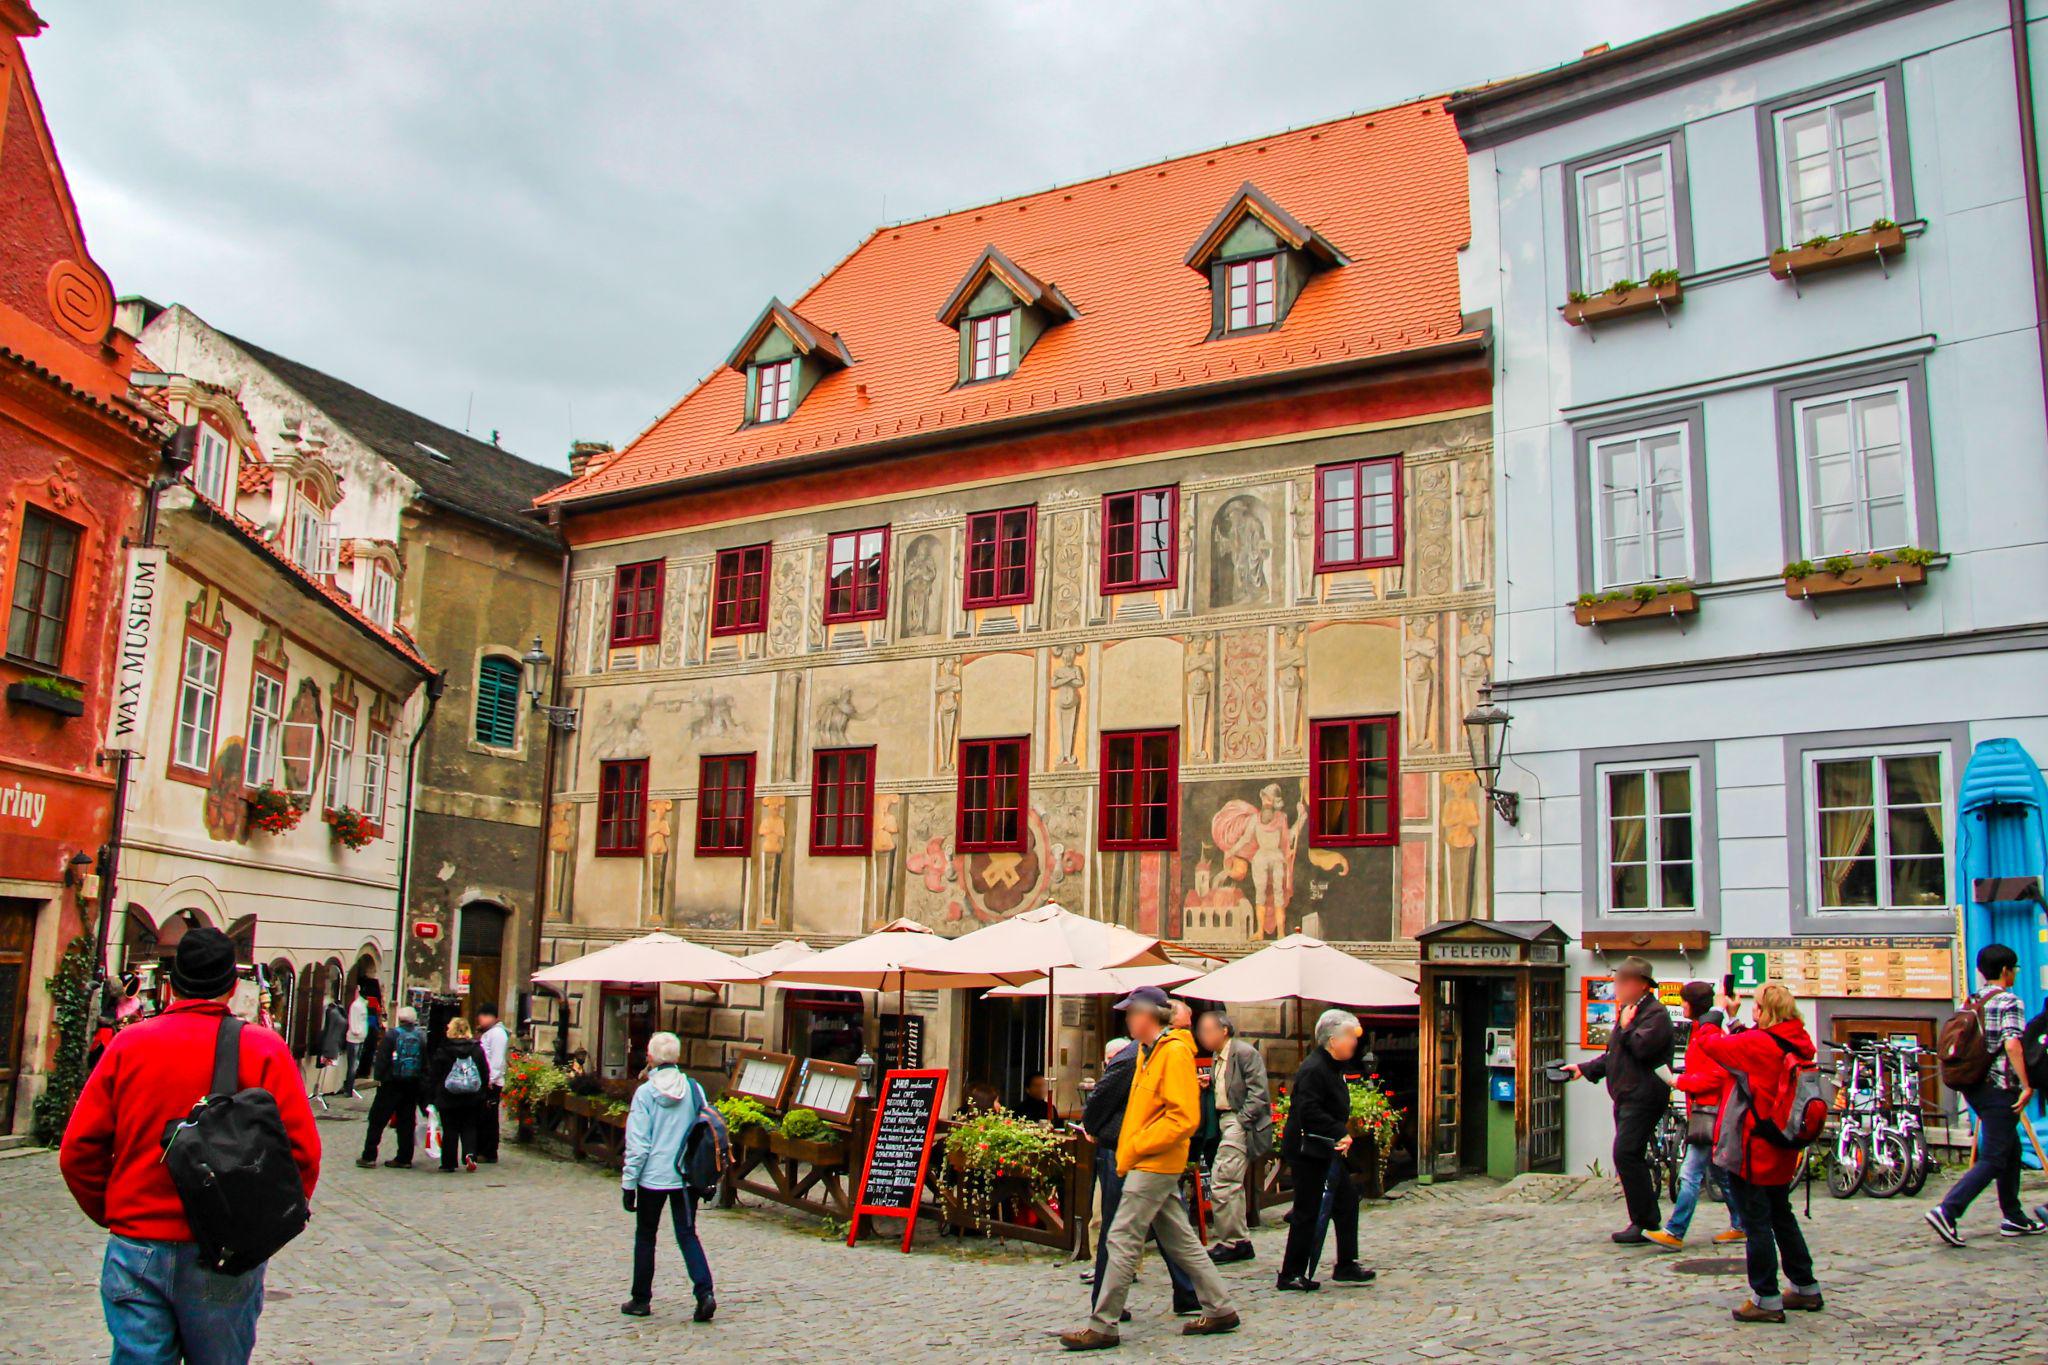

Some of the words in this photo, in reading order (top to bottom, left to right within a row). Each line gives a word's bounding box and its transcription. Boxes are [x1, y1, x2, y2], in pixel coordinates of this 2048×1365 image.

[122, 560, 157, 675] MUSEUM
[115, 680, 142, 738] WAX
[0, 782, 47, 828] riny
[911, 1099, 925, 1107] FOOD
